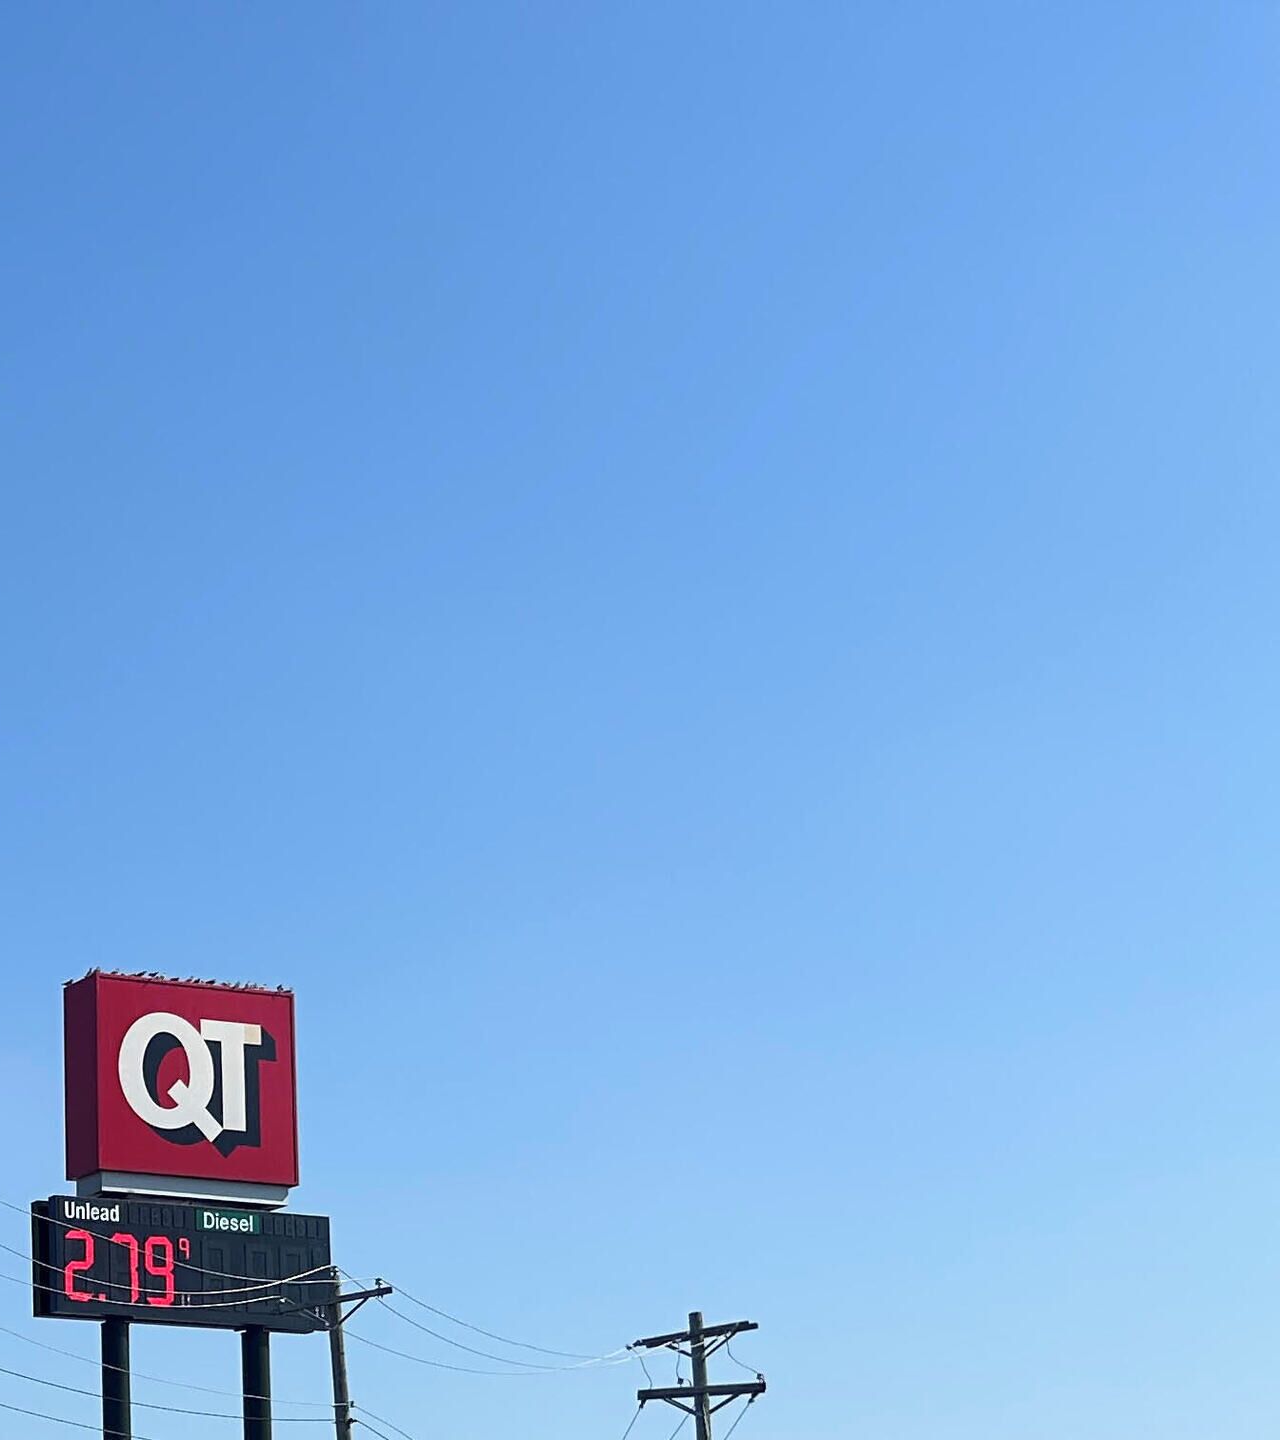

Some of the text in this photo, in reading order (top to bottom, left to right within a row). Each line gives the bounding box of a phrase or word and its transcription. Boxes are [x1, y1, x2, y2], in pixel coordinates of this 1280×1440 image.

[118, 1011, 262, 1143] QT
[64, 1201, 120, 1222] Unlead
[203, 1212, 254, 1232] Diesel
